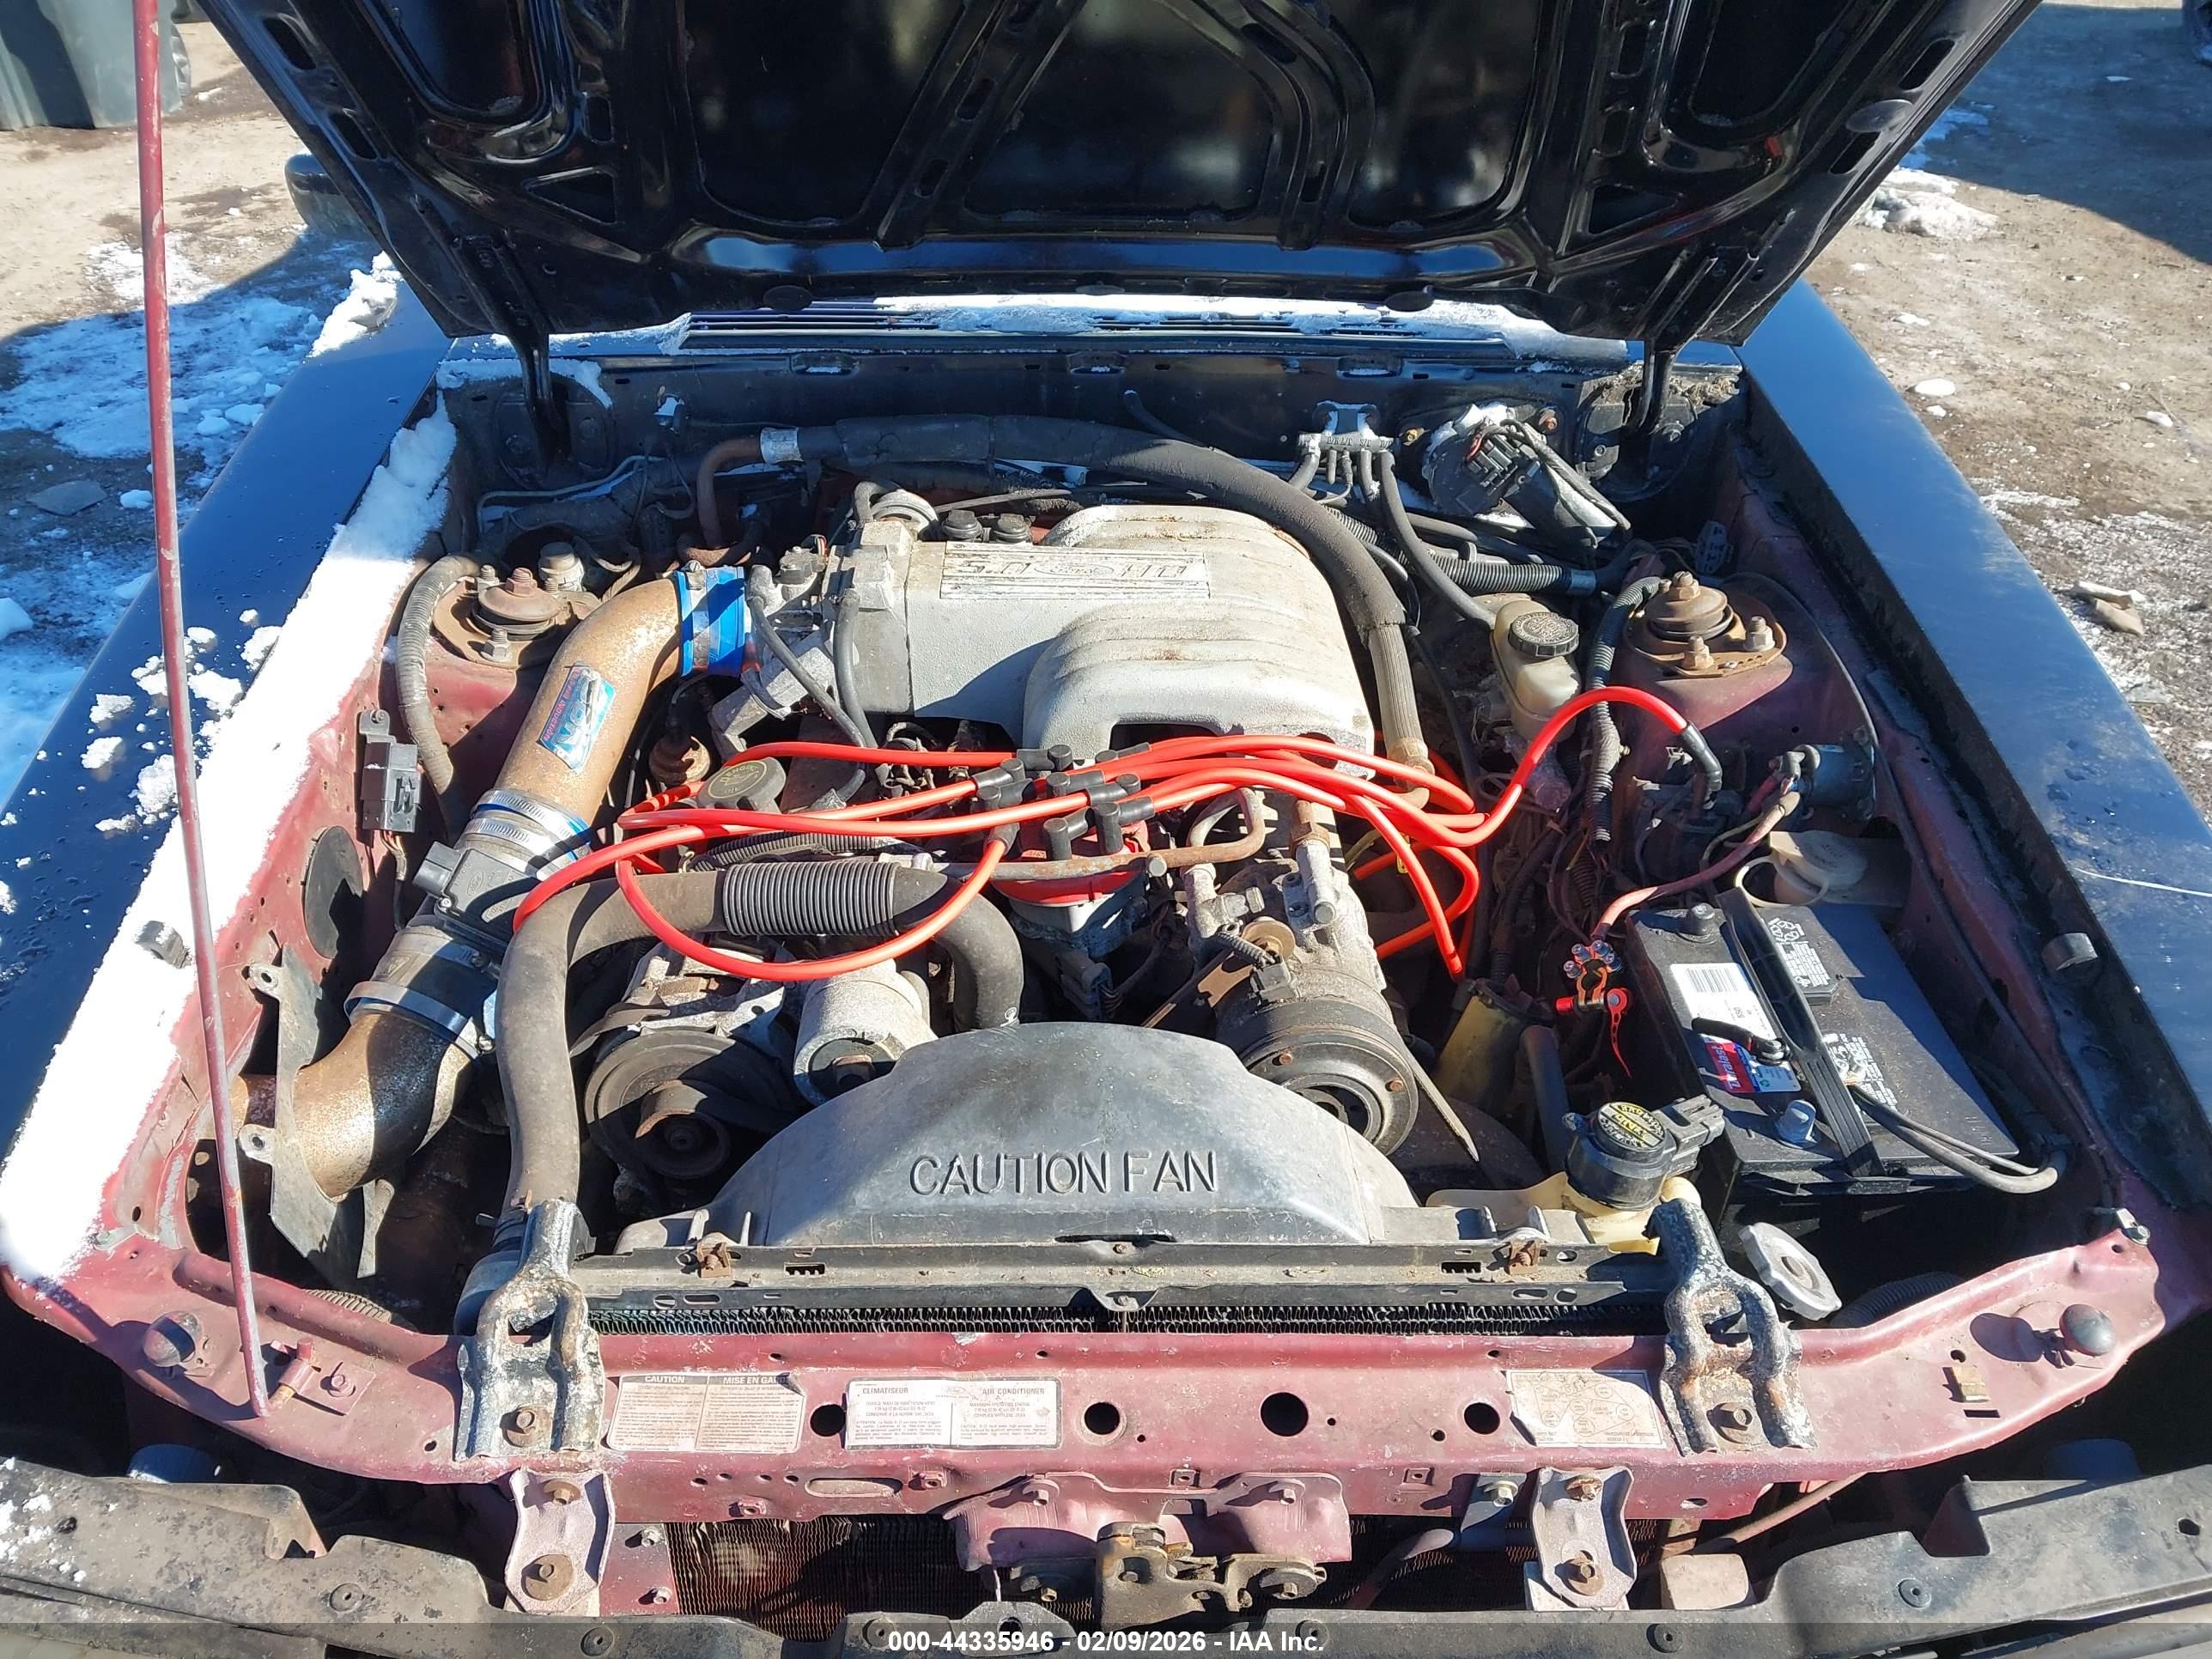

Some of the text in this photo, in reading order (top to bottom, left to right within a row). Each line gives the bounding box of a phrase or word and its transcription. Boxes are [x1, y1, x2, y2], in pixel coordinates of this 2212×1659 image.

[1711, 1044, 1741, 1090] Duralast
[910, 1149, 1218, 1195] CAUTION FAN
[723, 1376, 747, 1384] MISE
[747, 1376, 760, 1384] EN
